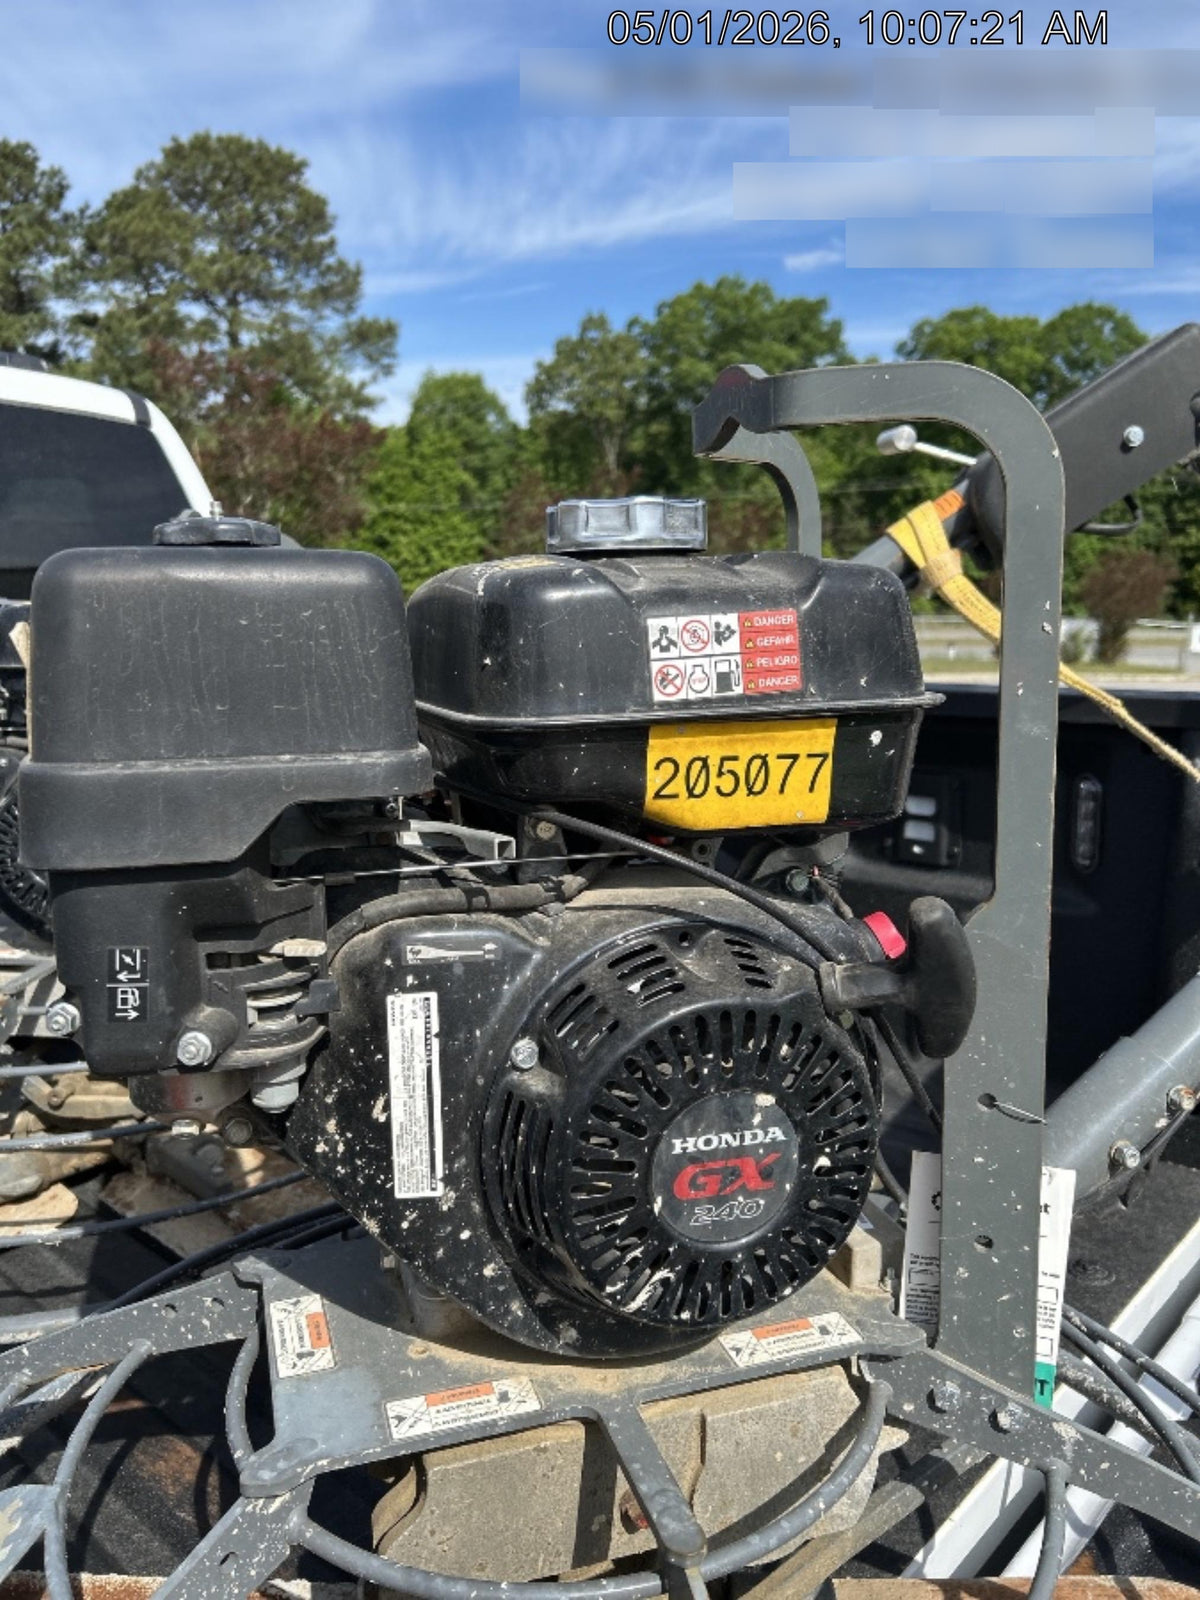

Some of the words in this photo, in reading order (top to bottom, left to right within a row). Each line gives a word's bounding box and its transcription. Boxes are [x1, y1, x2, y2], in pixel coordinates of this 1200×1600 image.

[753, 614, 794, 626] DANGER
[756, 634, 796, 647] GEFAHR
[756, 655, 798, 667] PELIGRO
[758, 674, 800, 687] DANGER
[652, 752, 830, 800] 205077
[671, 1126, 787, 1154] HONDA
[673, 1151, 782, 1200] GX
[689, 1197, 765, 1226] 240
